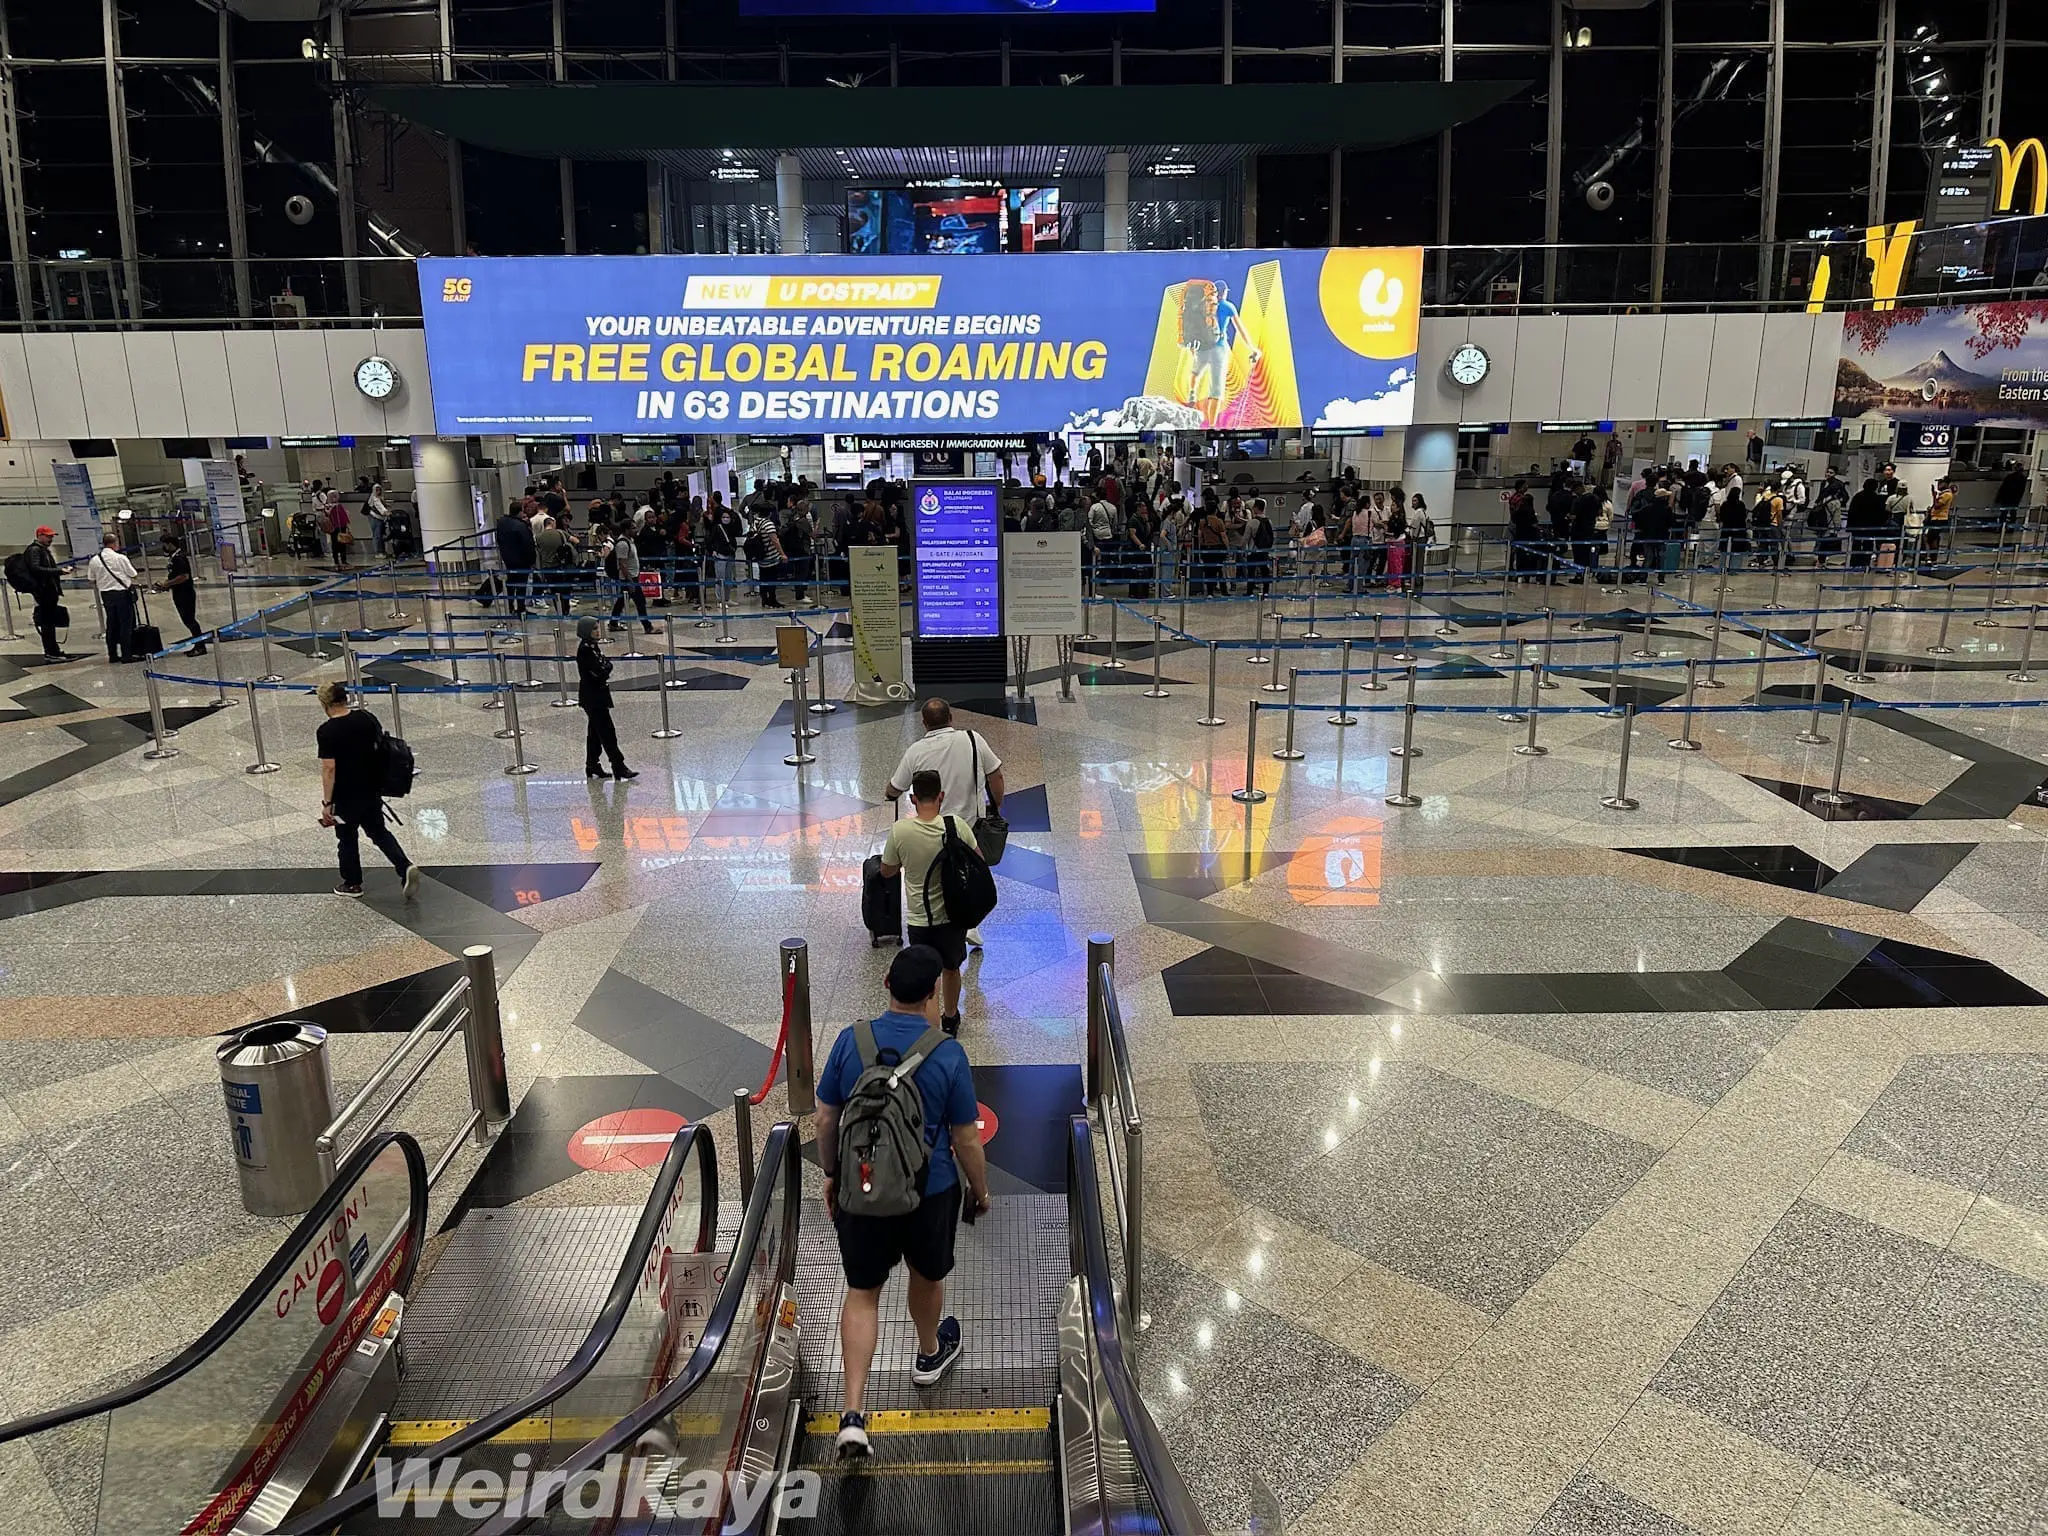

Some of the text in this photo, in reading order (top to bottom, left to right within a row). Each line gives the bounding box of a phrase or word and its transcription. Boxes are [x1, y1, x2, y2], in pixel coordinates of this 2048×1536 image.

[442, 277, 472, 295] 5G
[701, 283, 753, 299] NEW
[779, 283, 797, 301] U
[442, 294, 471, 303] READY
[585, 314, 1041, 336] YOUR UNBEATABLE ADVENTURE BEGINS
[522, 340, 1108, 383] FREE GLOBAL ROAMING
[2001, 367, 2029, 382] From
[1999, 384, 2041, 401] Eastern
[636, 389, 1000, 421] IN 63 DESTINATIONS
[861, 438, 1027, 449] BALAI IMIGRESEN / IMMIGRATION HALL
